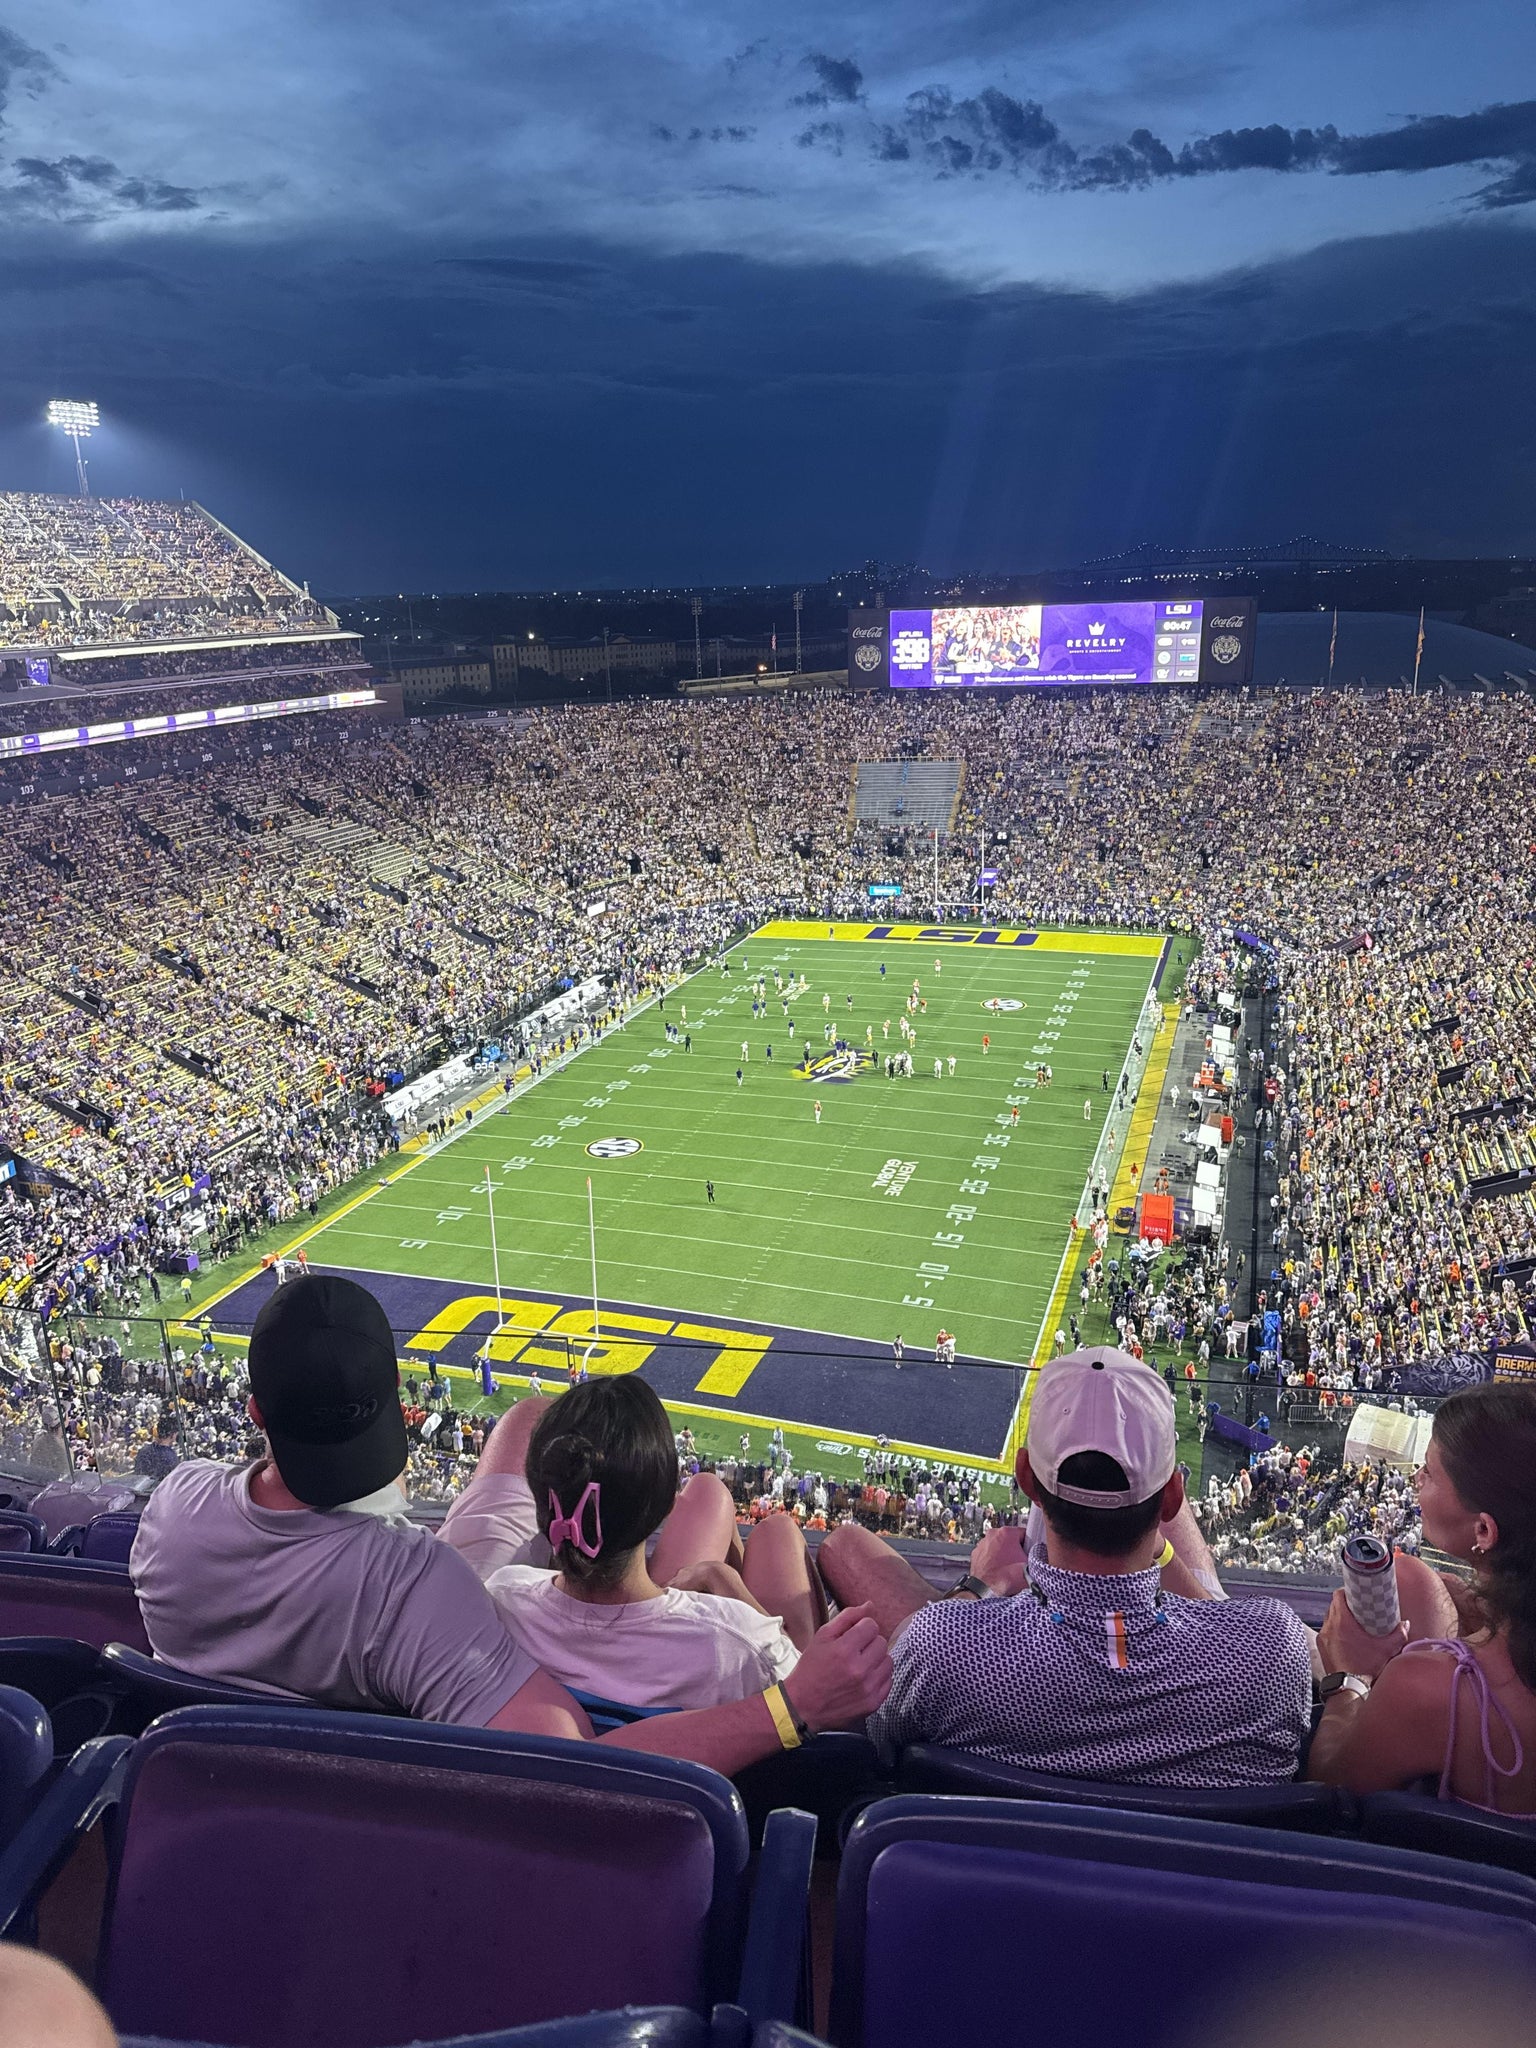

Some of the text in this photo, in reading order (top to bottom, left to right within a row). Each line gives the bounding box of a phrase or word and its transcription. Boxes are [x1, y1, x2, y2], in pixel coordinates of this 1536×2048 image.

[1165, 604, 1193, 615] LSU
[1066, 638, 1126, 648] REVELRY
[892, 638, 930, 664] 398
[339, 732, 349, 740] 223
[262, 744, 273, 752] 106
[202, 753, 213, 762] 105
[125, 767, 138, 776] 104
[20, 785, 34, 795] 103
[864, 926, 1040, 947] LSU
[530, 1135, 563, 1148] 25
[983, 1133, 1011, 1148] 35
[502, 1156, 535, 1170] 20
[971, 1155, 1001, 1170] 30
[871, 1158, 903, 1188] GLOBAL
[884, 1161, 920, 1197] VENTURE
[959, 1178, 989, 1195] 25
[164, 1187, 191, 1211] LSU
[436, 1205, 472, 1221] 10
[946, 1204, 978, 1221] 20
[398, 1240, 428, 1250] 5
[932, 1231, 965, 1249] 15
[915, 1262, 950, 1281] 10
[902, 1294, 935, 1307] 5
[404, 1295, 775, 1398] LSU
[1494, 1369, 1523, 1377] COME
